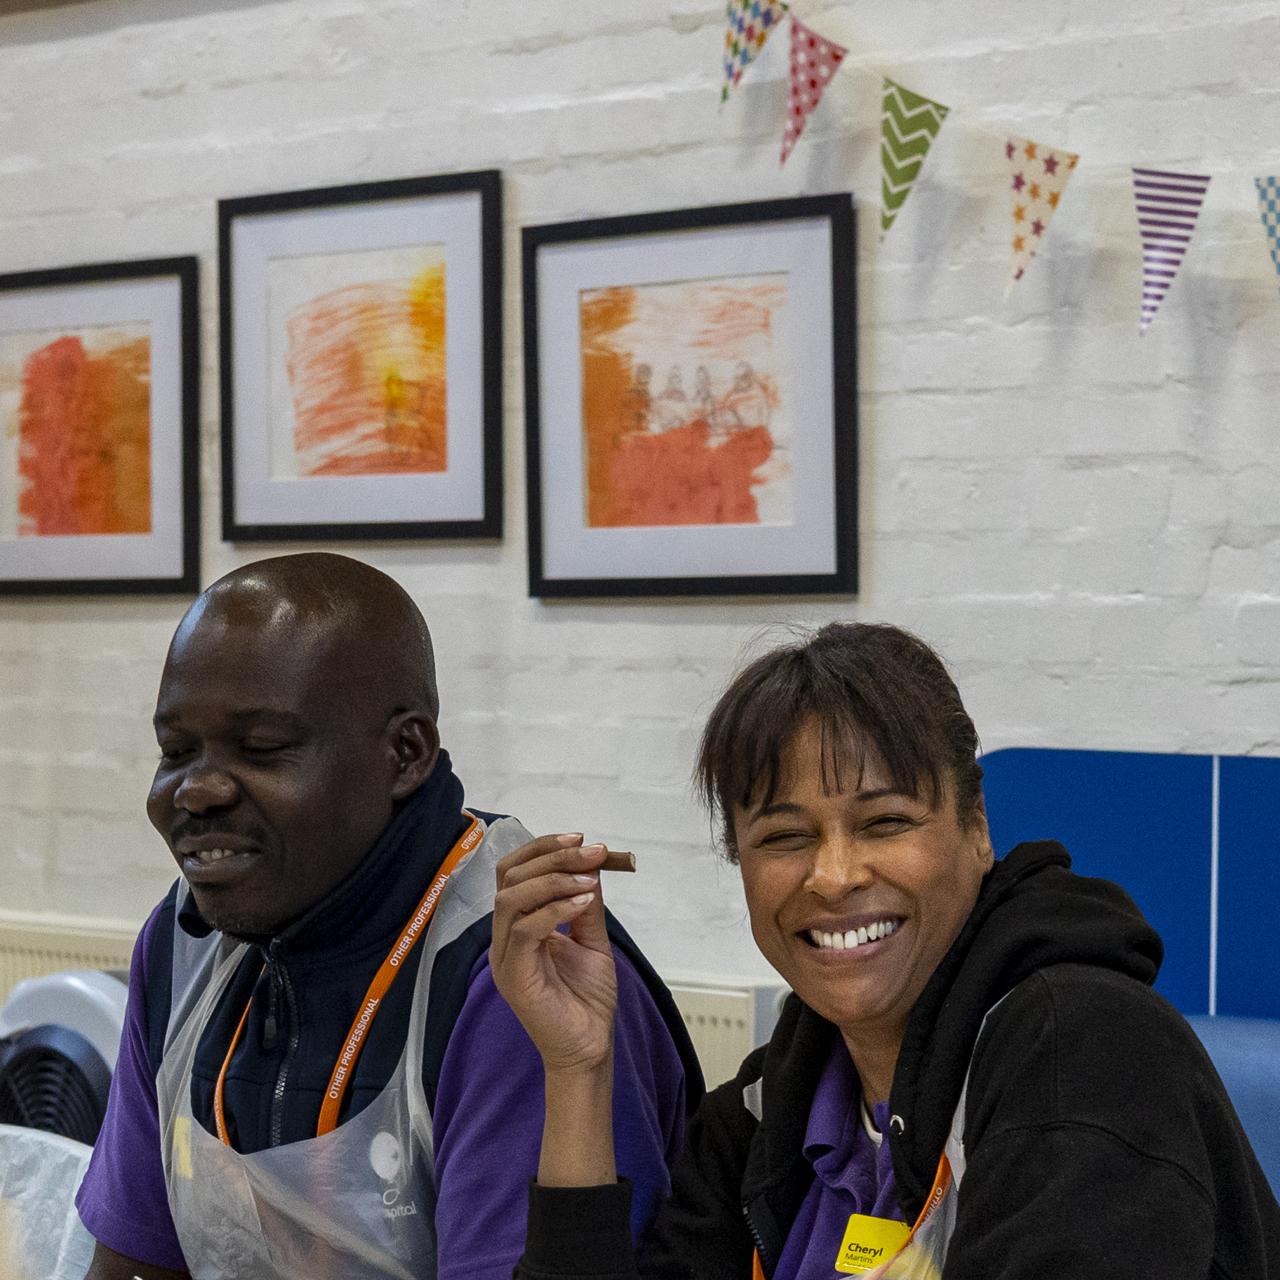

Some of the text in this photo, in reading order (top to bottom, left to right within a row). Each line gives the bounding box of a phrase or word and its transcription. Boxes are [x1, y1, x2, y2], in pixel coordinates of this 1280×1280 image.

[390, 873, 450, 967] OTHER PROFESSIONAL
[329, 997, 380, 1099] OTHER PROFESSIONAL
[848, 1242, 884, 1258] Cheryl
